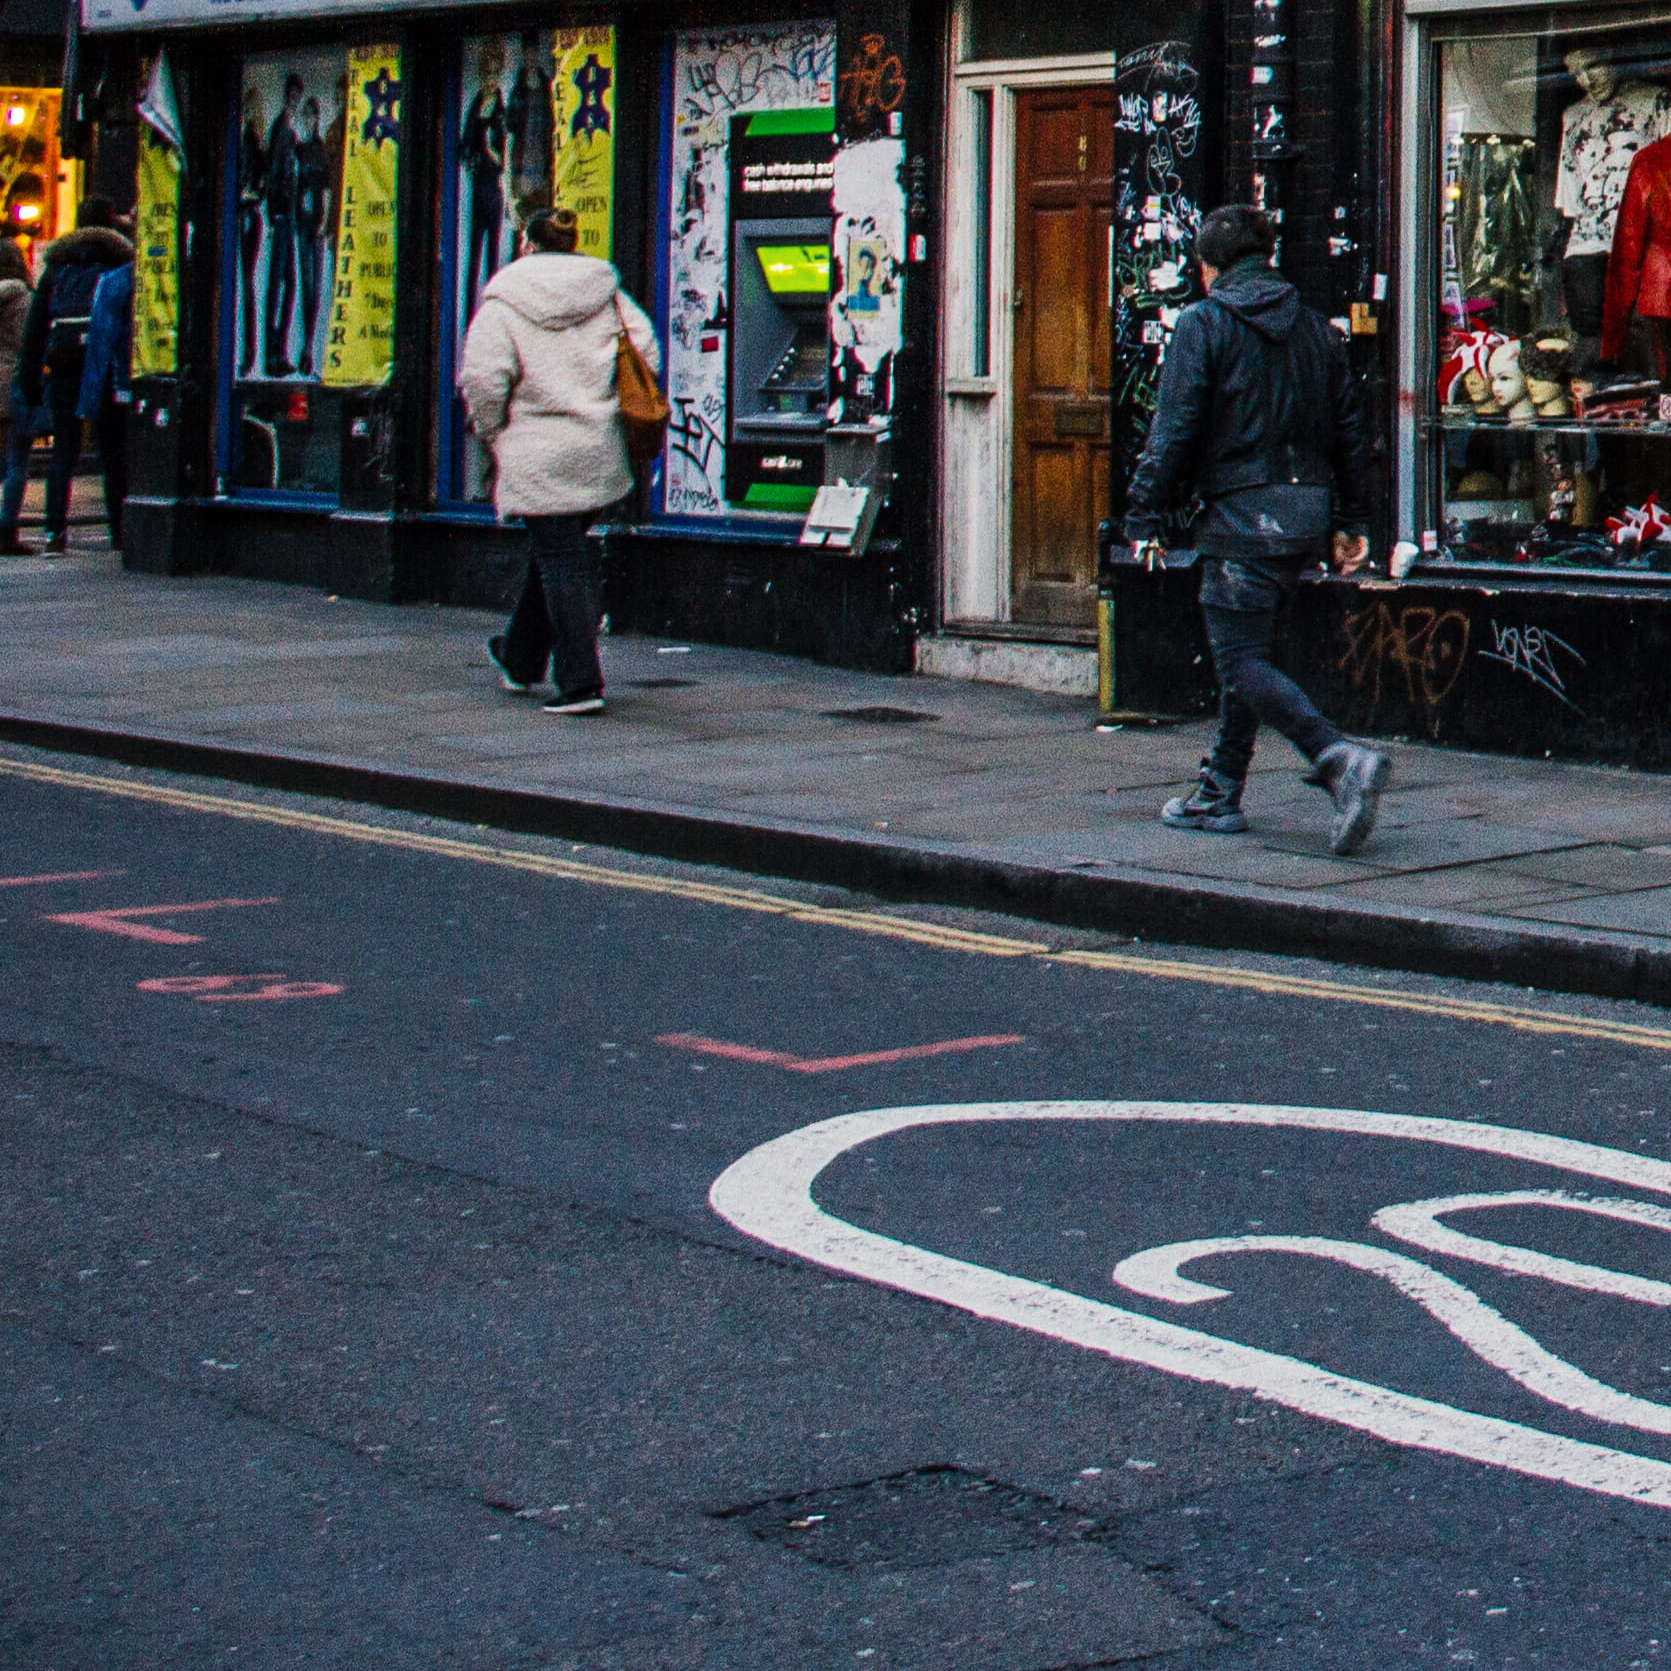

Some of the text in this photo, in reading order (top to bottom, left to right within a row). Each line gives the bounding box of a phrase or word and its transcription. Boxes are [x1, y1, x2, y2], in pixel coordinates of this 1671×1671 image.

[576, 196, 607, 215] OPEN
[582, 230, 600, 246] TO
[329, 186, 358, 369] LEATHERS
